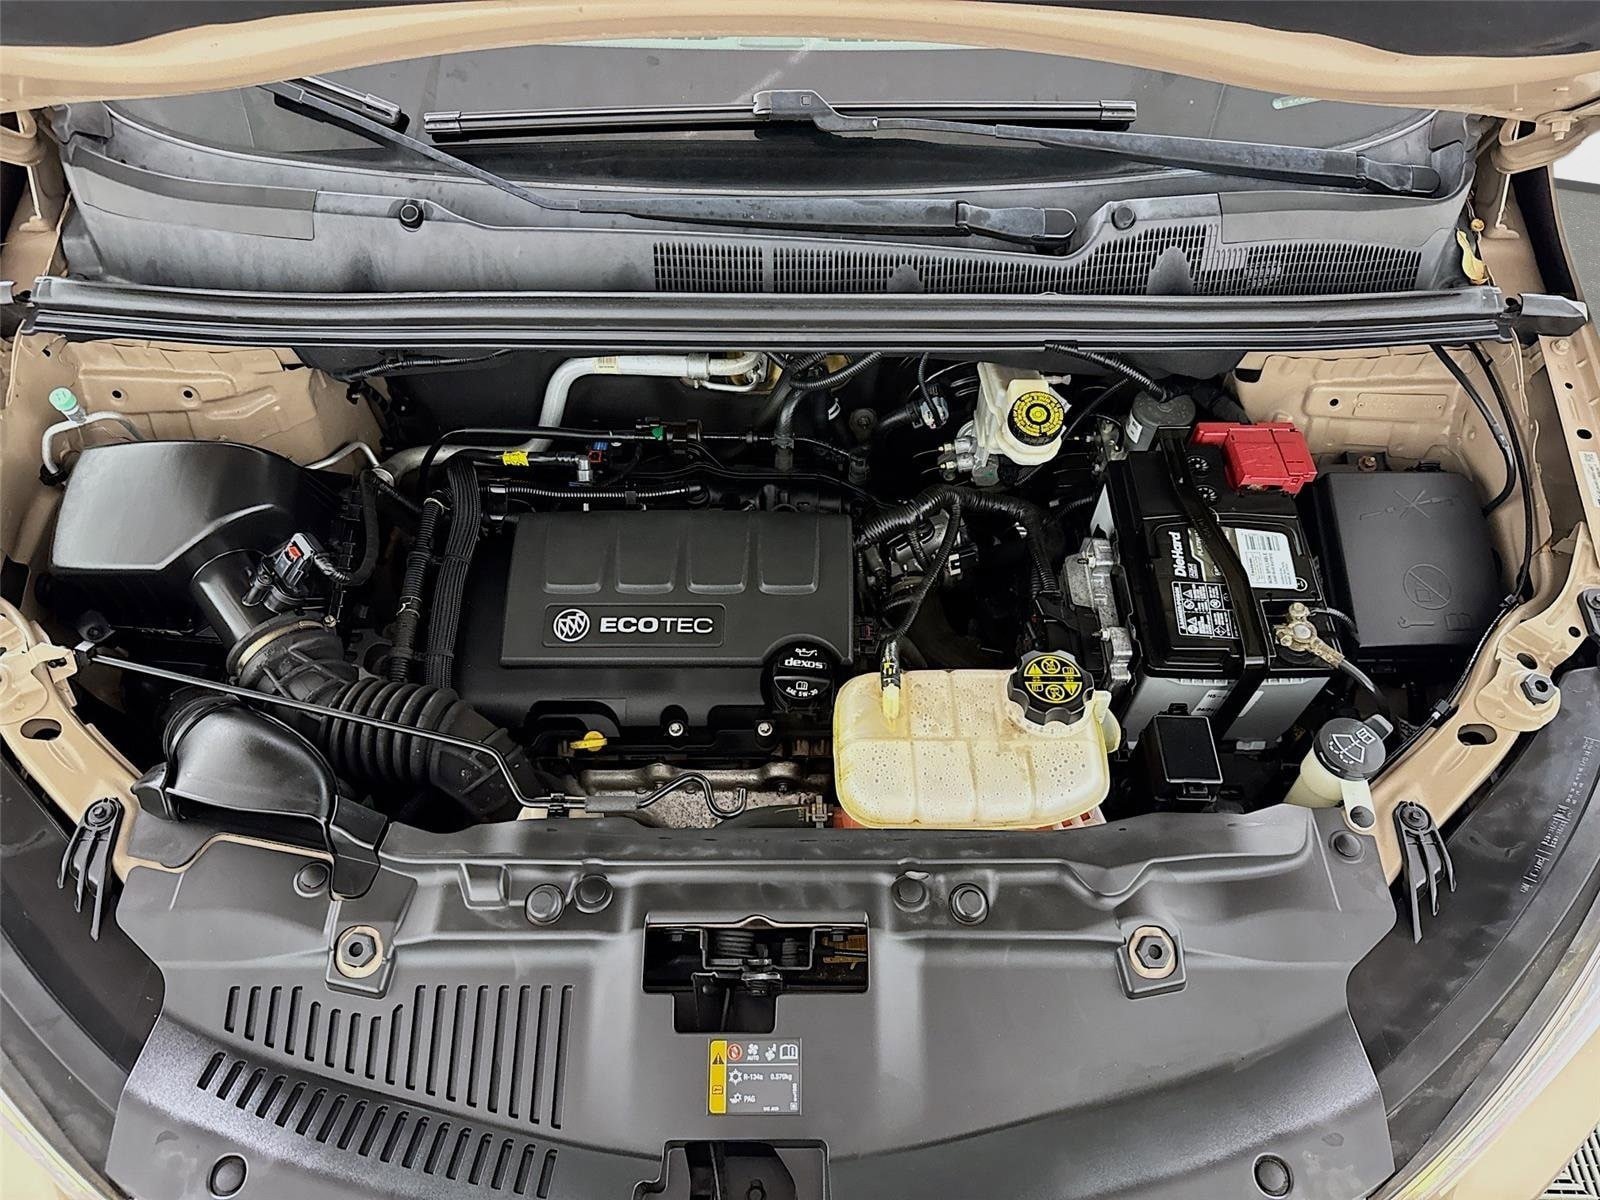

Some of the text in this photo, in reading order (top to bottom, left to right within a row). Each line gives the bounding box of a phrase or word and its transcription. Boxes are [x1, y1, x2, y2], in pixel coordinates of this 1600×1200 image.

[1168, 531, 1187, 577] DieHard
[599, 617, 713, 634] ECOTEC
[784, 657, 823, 669] dexos
[785, 686, 797, 696] SAE
[743, 1073, 763, 1081] R-134a
[743, 1095, 756, 1103] PAG
